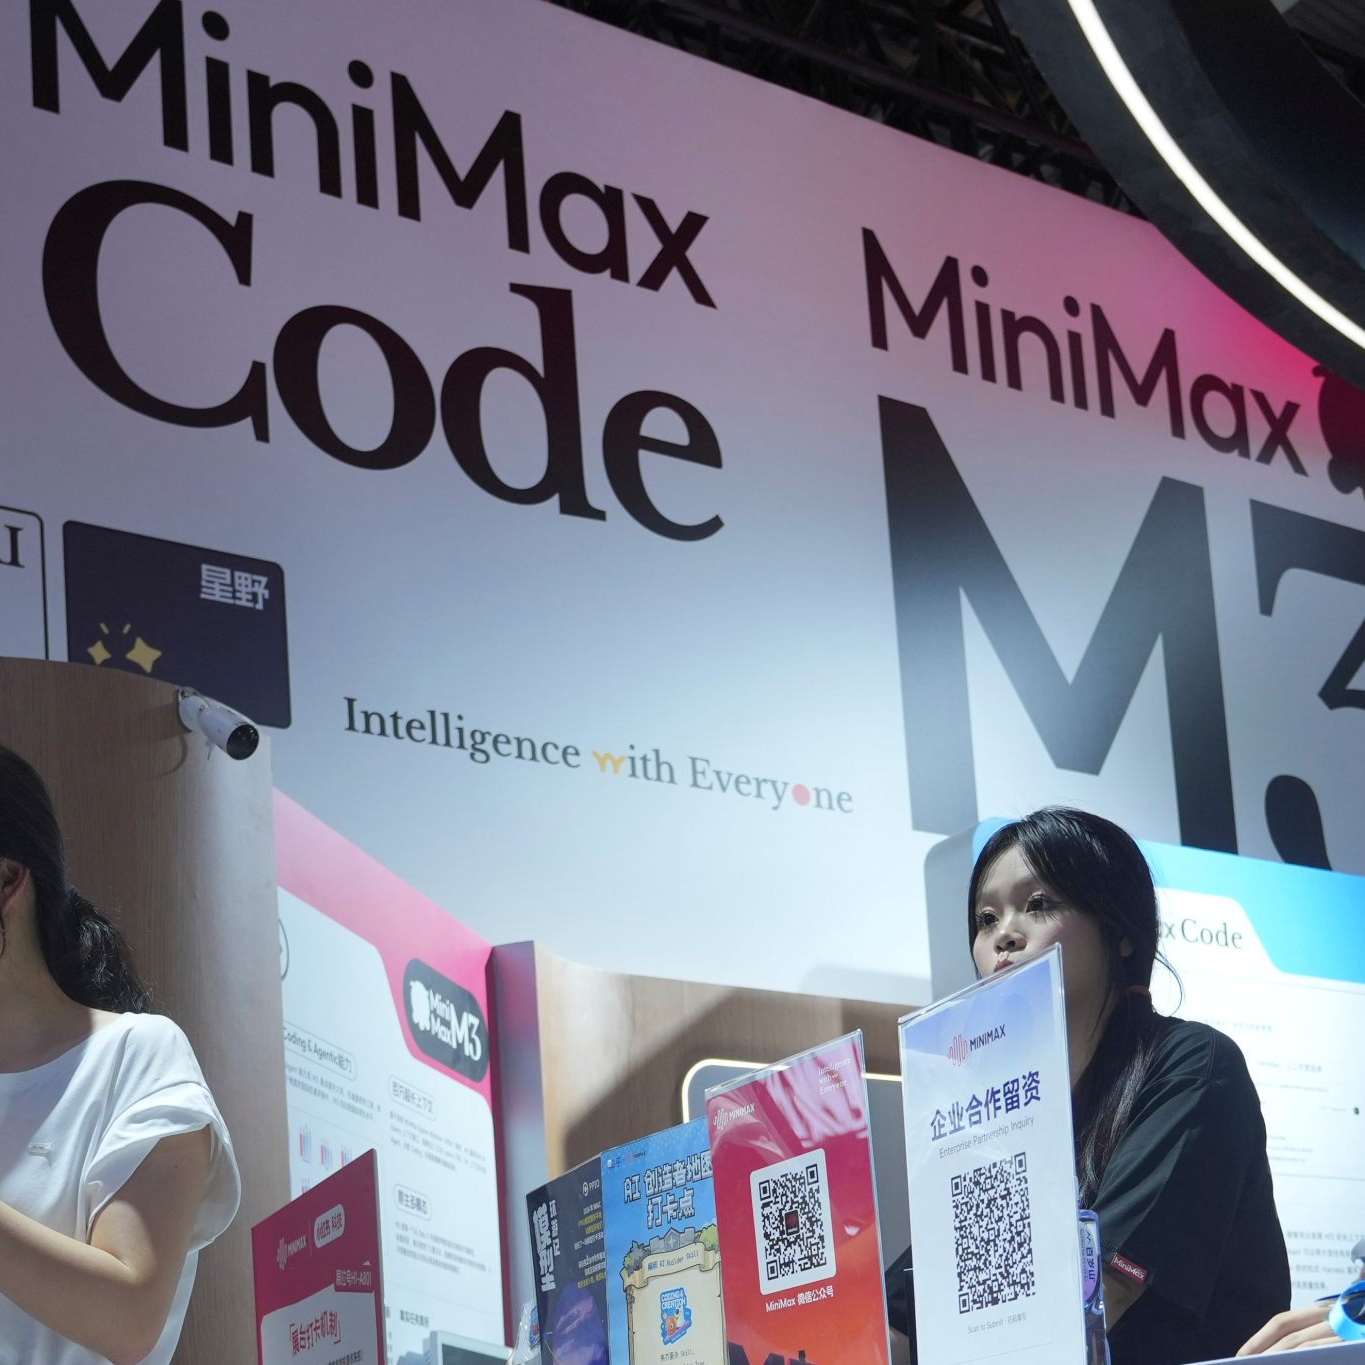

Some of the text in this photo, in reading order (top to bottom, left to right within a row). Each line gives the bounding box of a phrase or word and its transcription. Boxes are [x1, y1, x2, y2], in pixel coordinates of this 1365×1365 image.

[29, 0, 718, 309] MiniMax
[42, 179, 725, 541] Code
[861, 226, 1309, 477] MiniMax
[200, 562, 269, 610] 星野
[343, 696, 582, 763] Intelligence
[1181, 918, 1243, 949] Code
[430, 986, 451, 1022] Mini
[431, 1013, 453, 1046] Max
[450, 1003, 482, 1061] M3
[970, 1024, 1006, 1052] MINIMAX
[729, 1103, 755, 1122] MINIMAX
[930, 1071, 1041, 1142] 企业合作留资
[939, 1115, 1035, 1159] Enterprise Partnership Inquiry
[624, 1174, 642, 1203] AI
[647, 1187, 695, 1229] 打卡点
[1114, 1256, 1145, 1280] MiniMax
[766, 1285, 834, 1313] MiniMax 微信公众号
